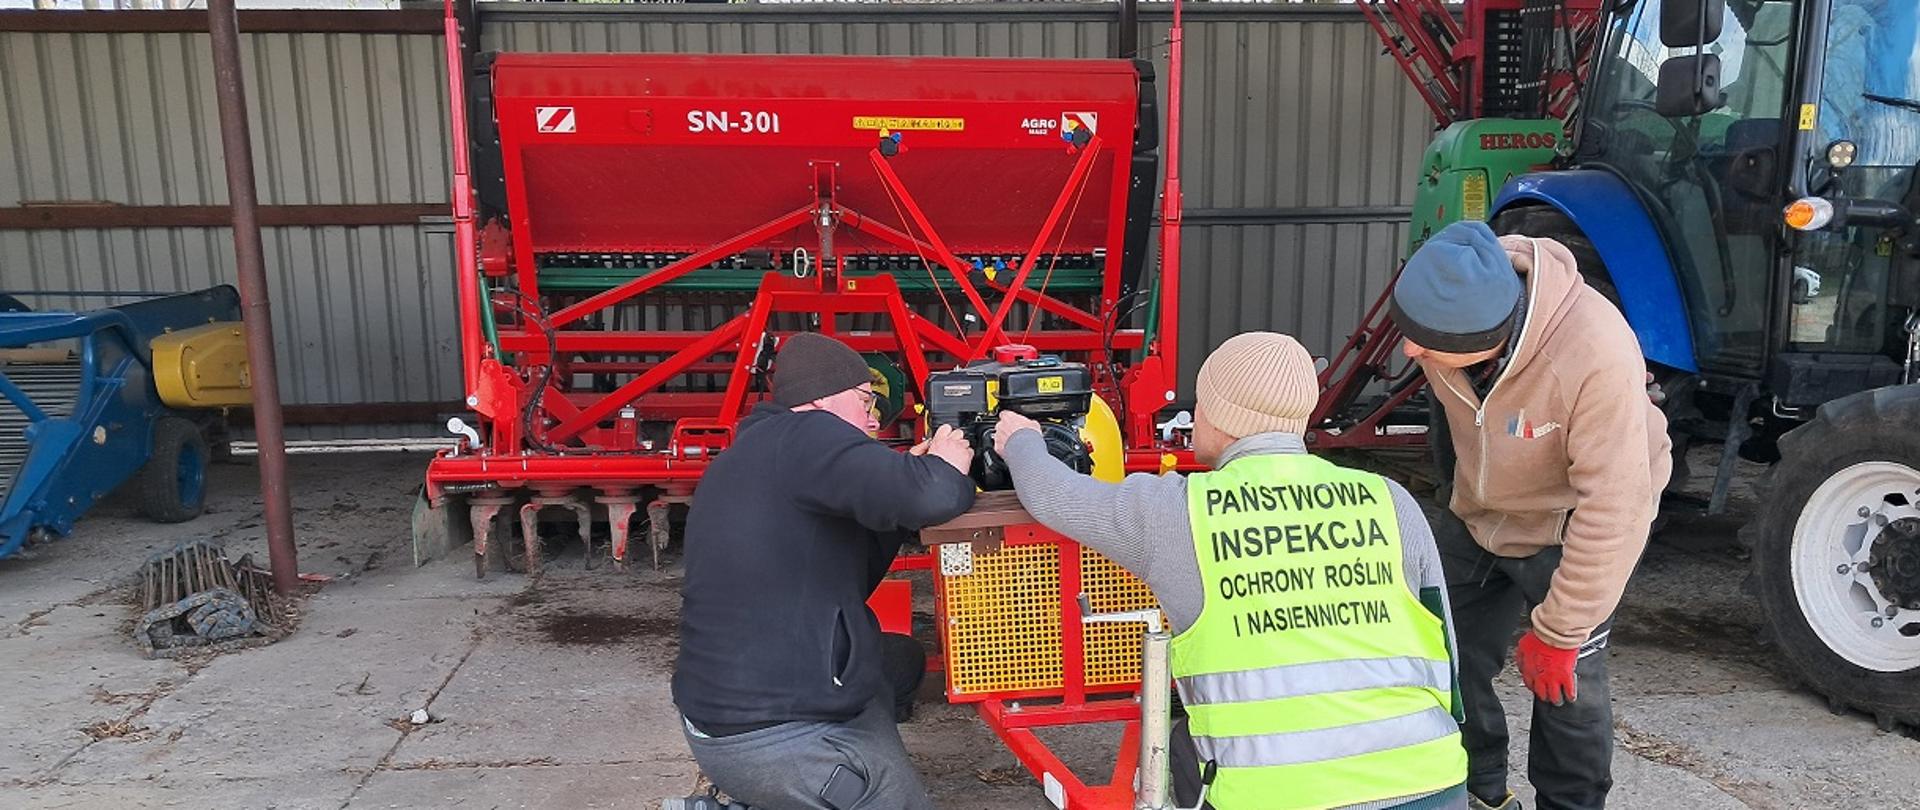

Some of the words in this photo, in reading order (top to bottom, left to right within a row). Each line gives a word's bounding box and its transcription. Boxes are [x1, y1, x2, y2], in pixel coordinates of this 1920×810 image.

[687, 110, 780, 133] SN-301
[1021, 118, 1057, 129] AGRO
[1480, 132, 1556, 149] HEROS
[1206, 482, 1377, 516] PAŃSTWOWA
[1211, 518, 1389, 562] INSPEKCJA
[1219, 567, 1315, 600] OCHRONY
[1324, 557, 1393, 591] ROŚLIN
[1233, 614, 1241, 637] I
[1247, 600, 1391, 636] NASIENNICTWA
